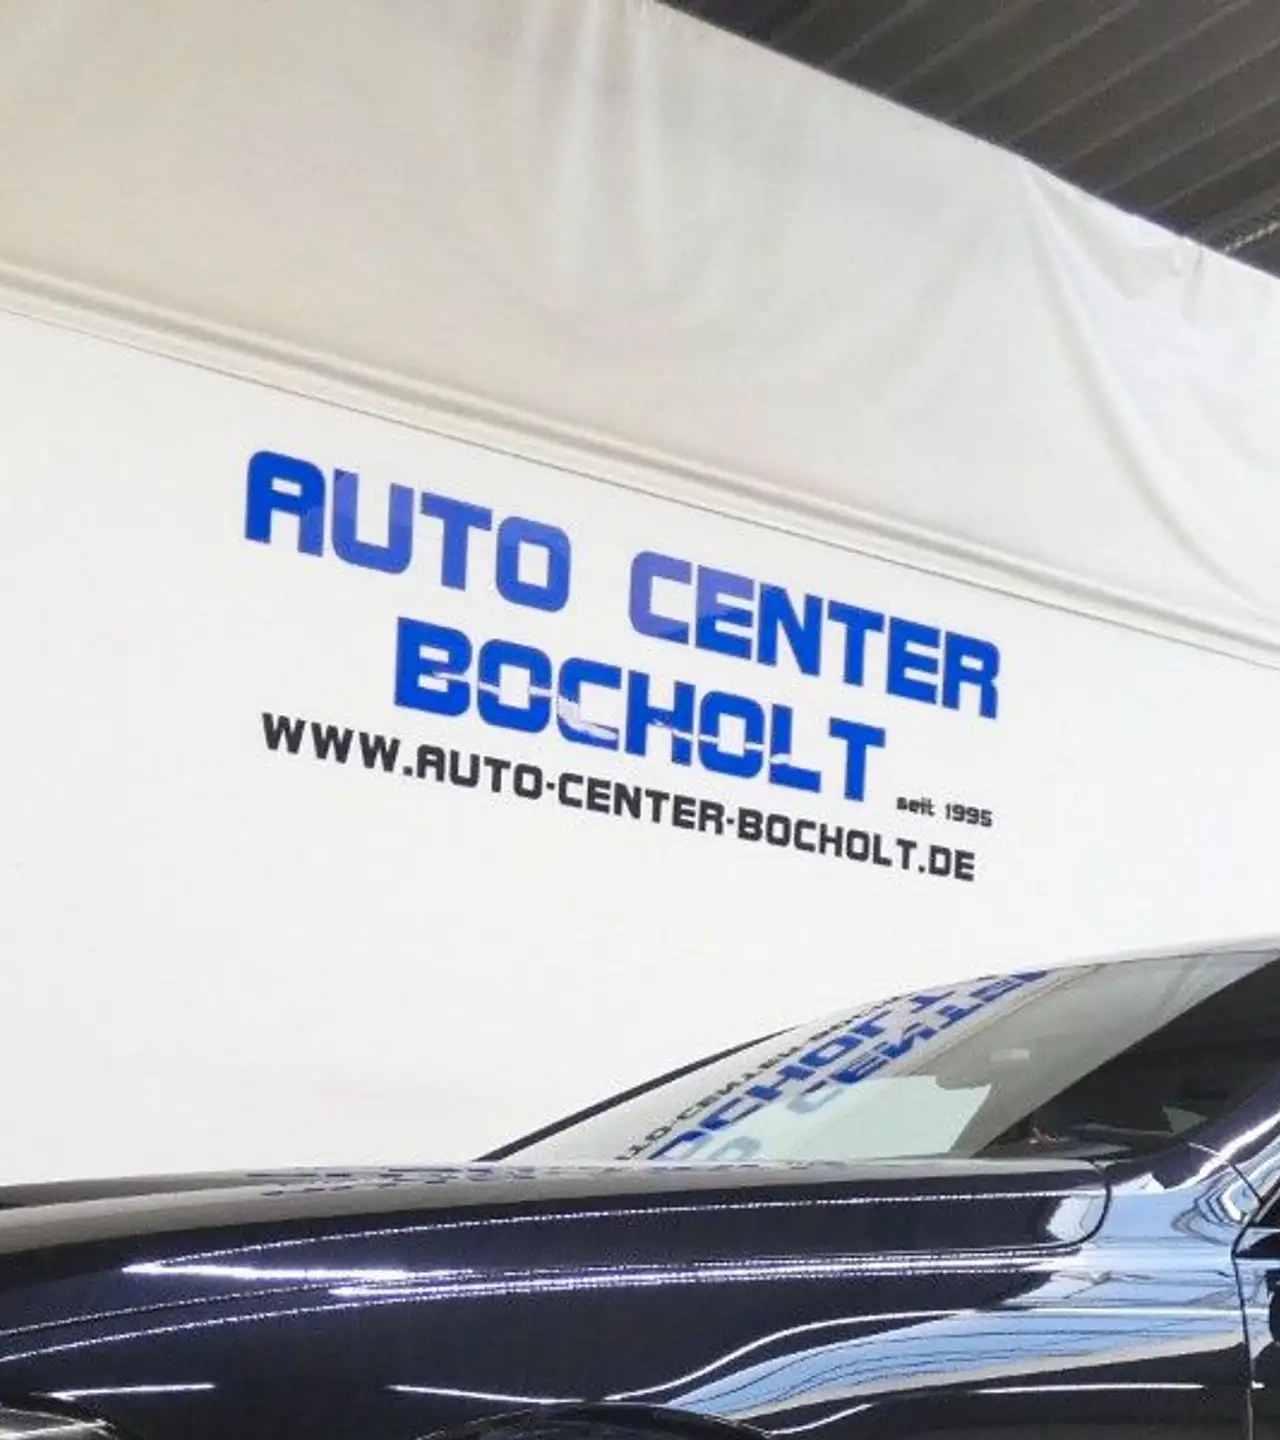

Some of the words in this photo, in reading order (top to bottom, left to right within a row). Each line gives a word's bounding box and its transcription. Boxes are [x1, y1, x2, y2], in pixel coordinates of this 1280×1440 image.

[245, 451, 571, 613] AUTO
[629, 551, 1000, 719] CENTER
[262, 712, 976, 882] WWW.AUTO-CENTER-BOCHOLT.DE
[394, 616, 886, 803] BOCHOLT
[945, 802, 993, 828] 1995
